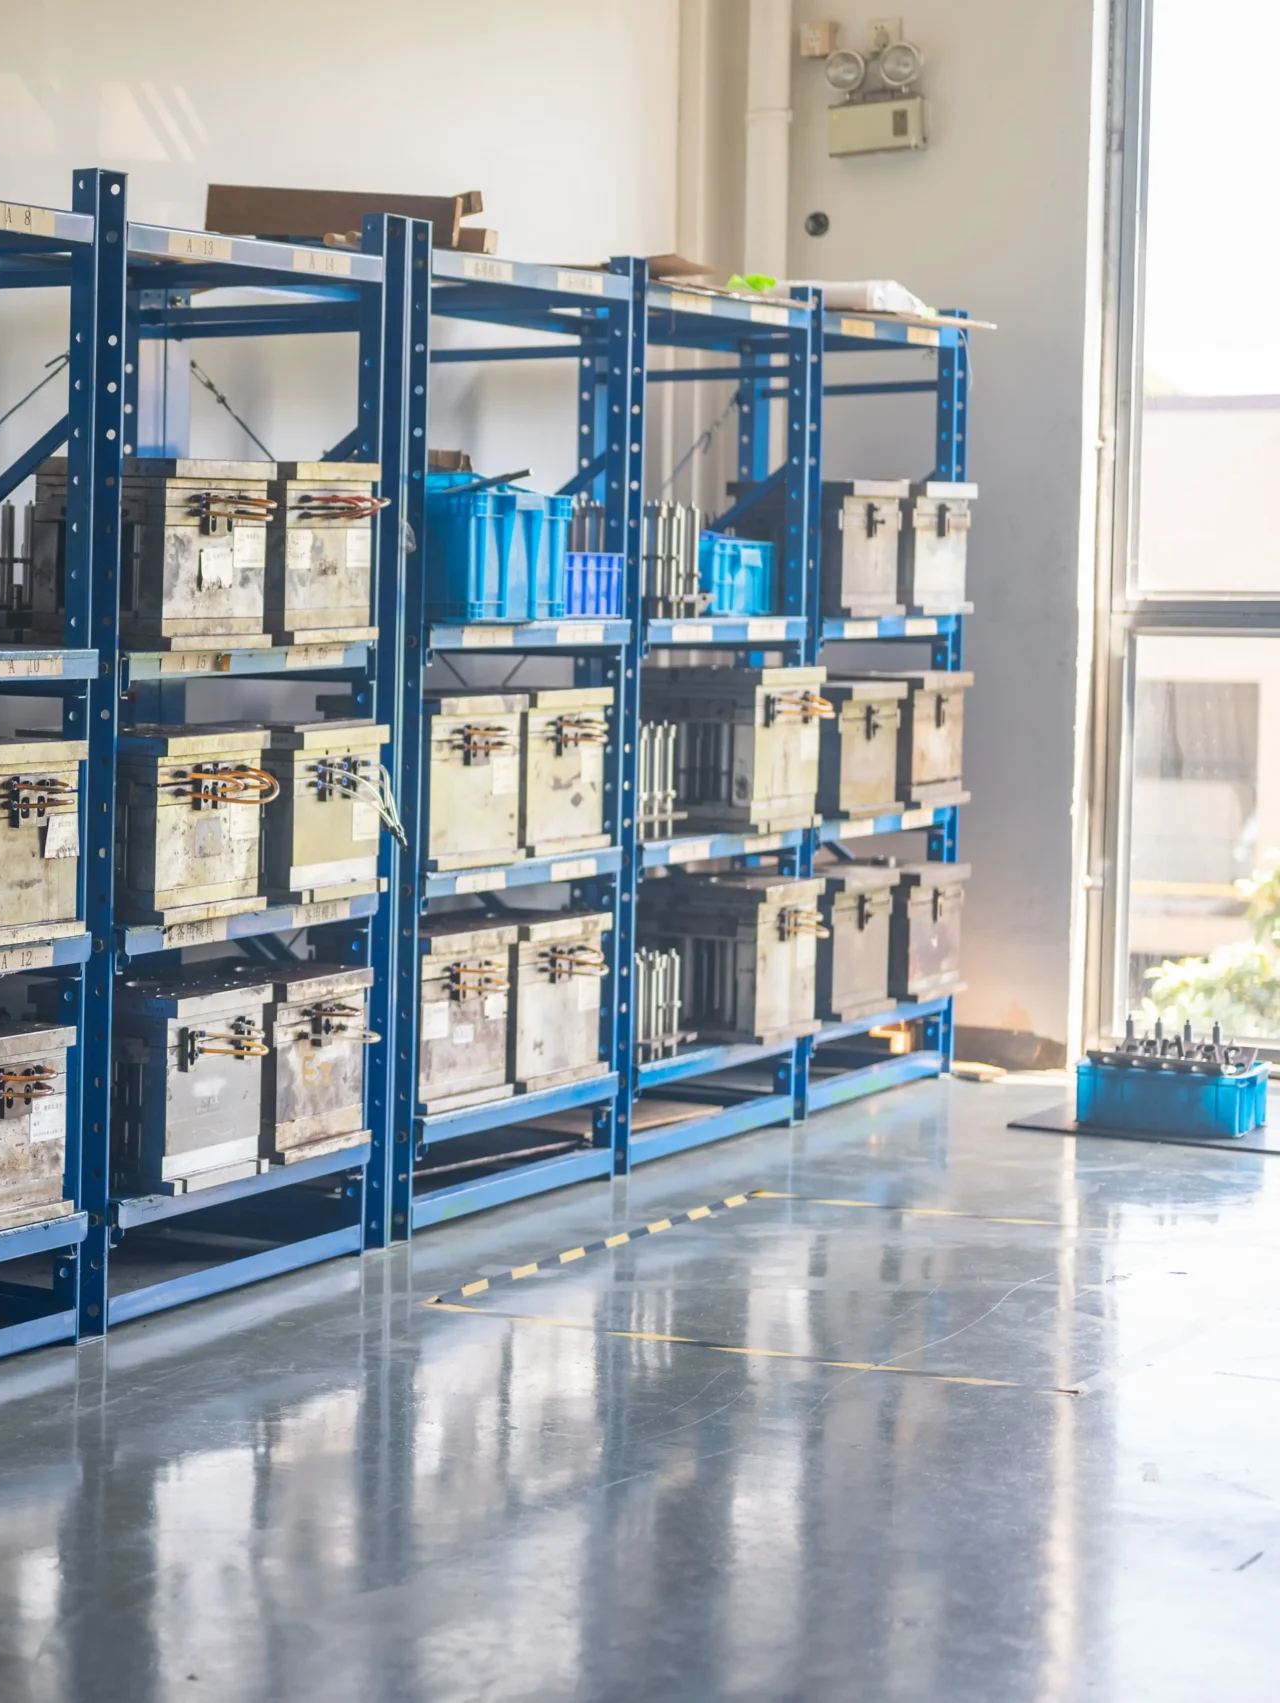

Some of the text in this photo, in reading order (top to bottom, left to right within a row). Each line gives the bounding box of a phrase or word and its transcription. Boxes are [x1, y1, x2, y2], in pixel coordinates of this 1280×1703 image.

[6, 206, 32, 226] A 8
[186, 238, 214, 256] A 13
[309, 252, 334, 271] A 14
[8, 659, 40, 674] A 10
[180, 655, 206, 670] A 15
[1, 950, 32, 970] A 12
